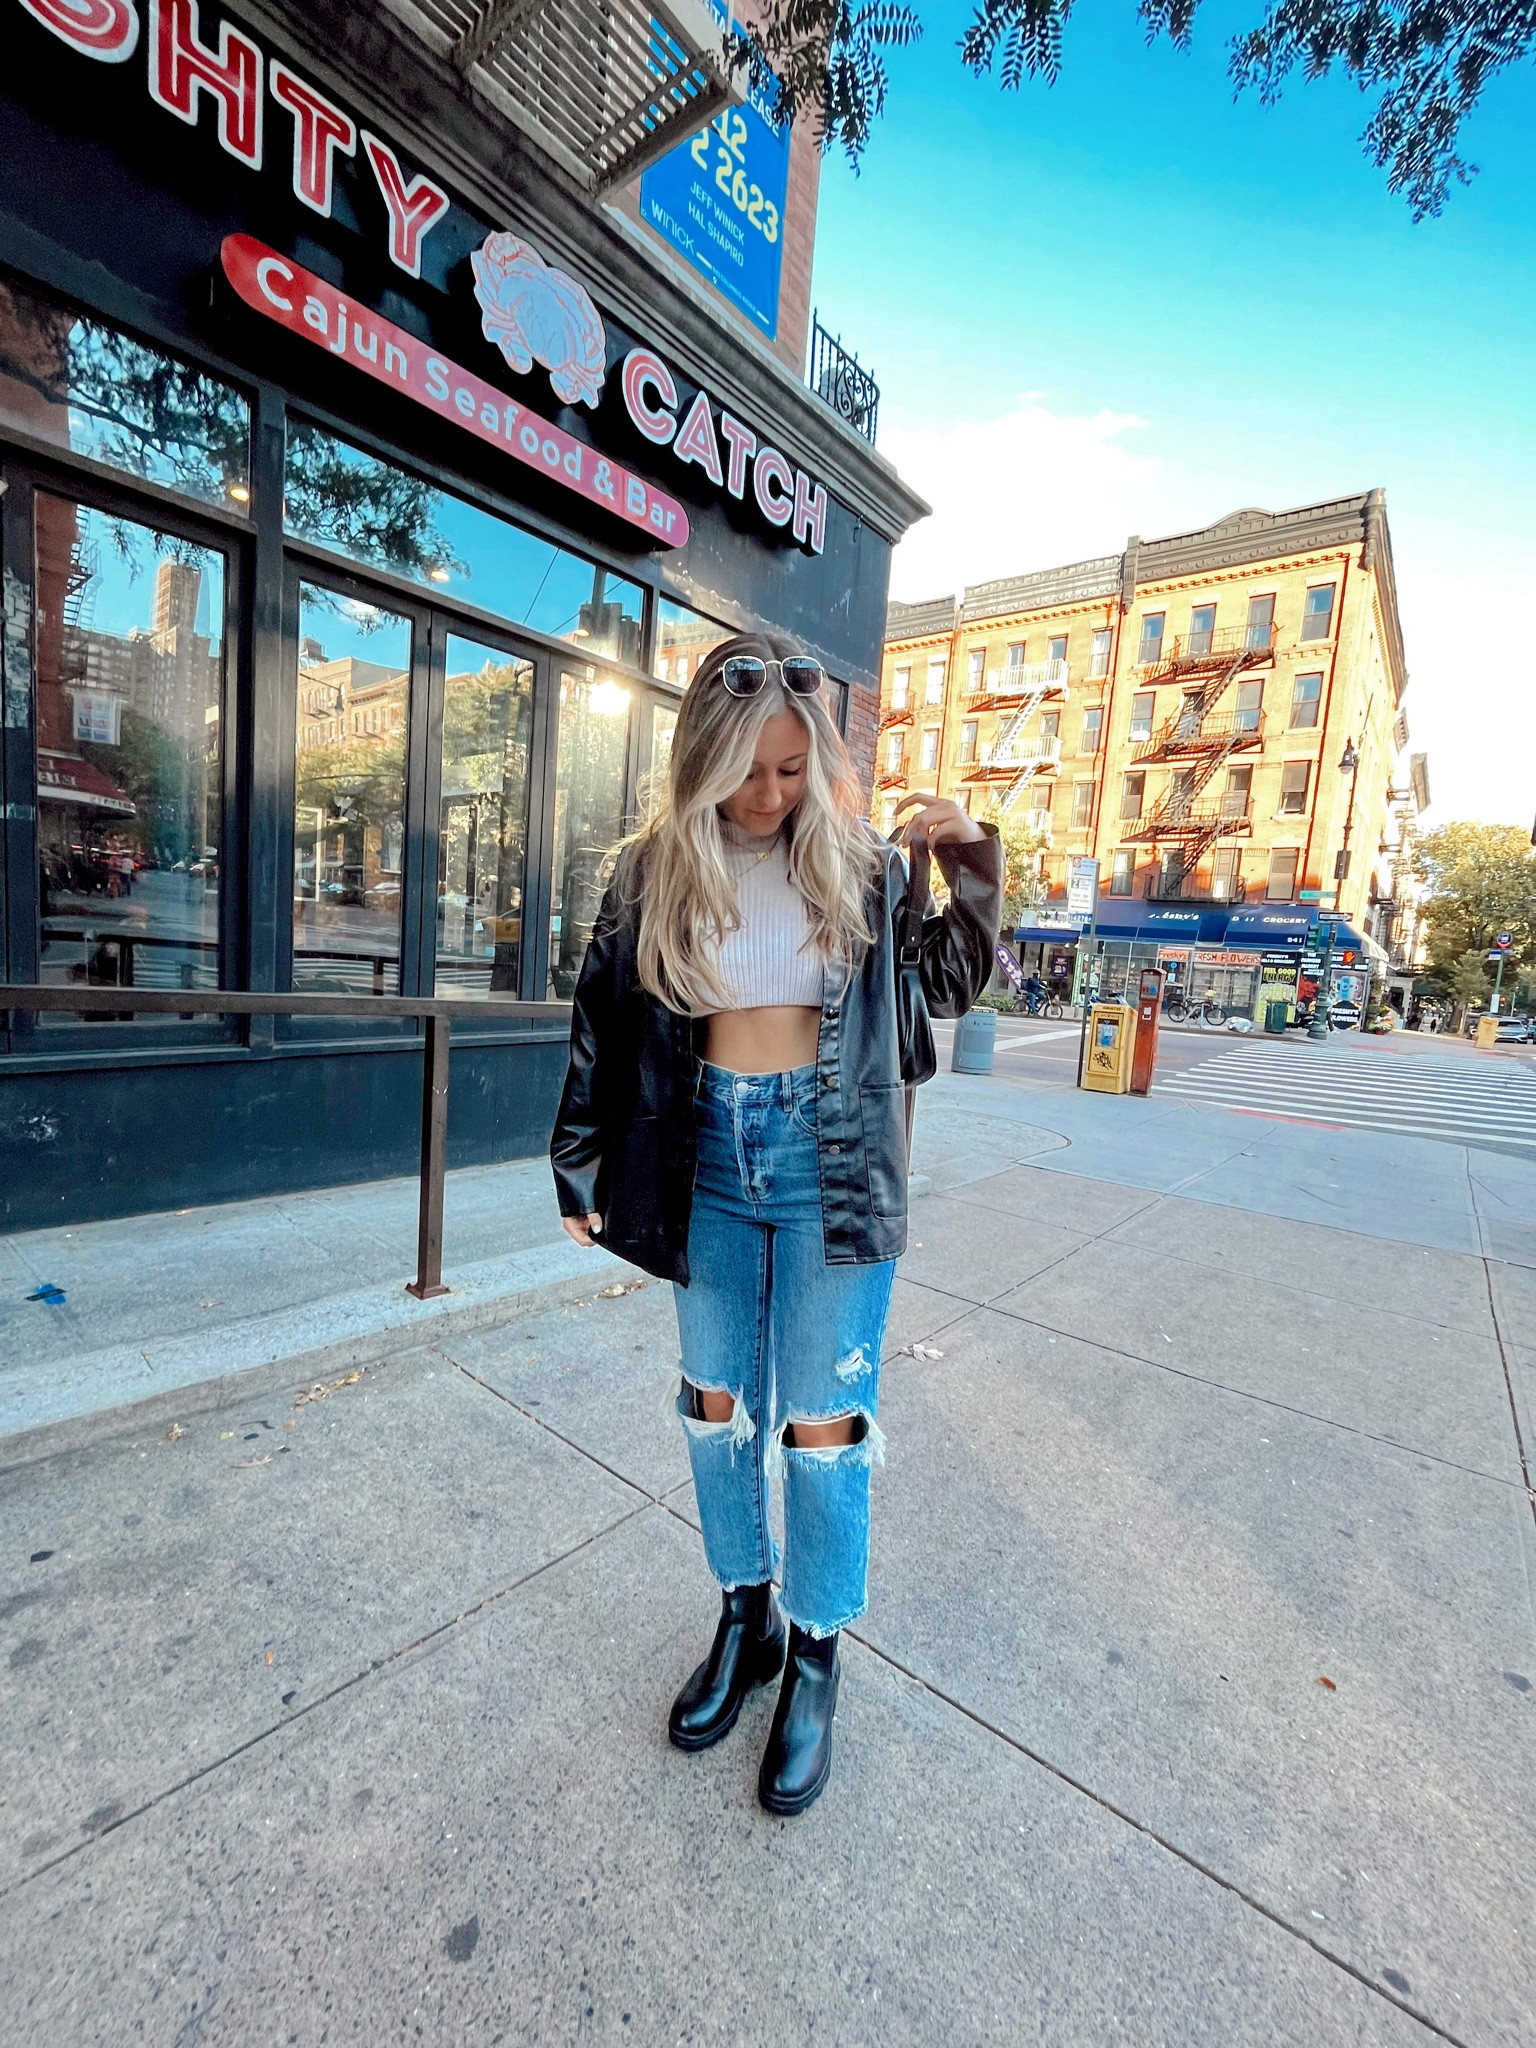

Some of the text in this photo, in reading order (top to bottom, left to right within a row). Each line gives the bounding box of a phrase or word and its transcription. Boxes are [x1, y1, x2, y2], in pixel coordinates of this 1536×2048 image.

[711, 108, 747, 165] 12
[690, 181, 745, 246] JEFF WINICK
[716, 147, 779, 244] 2623
[688, 201, 744, 268] HAL SHAPIRO
[256, 256, 676, 533] Cajun Seafood & Bar
[621, 347, 828, 555] CATCH
[1221, 953, 1261, 964] FOWERS
[1263, 974, 1296, 983] ENERGY
